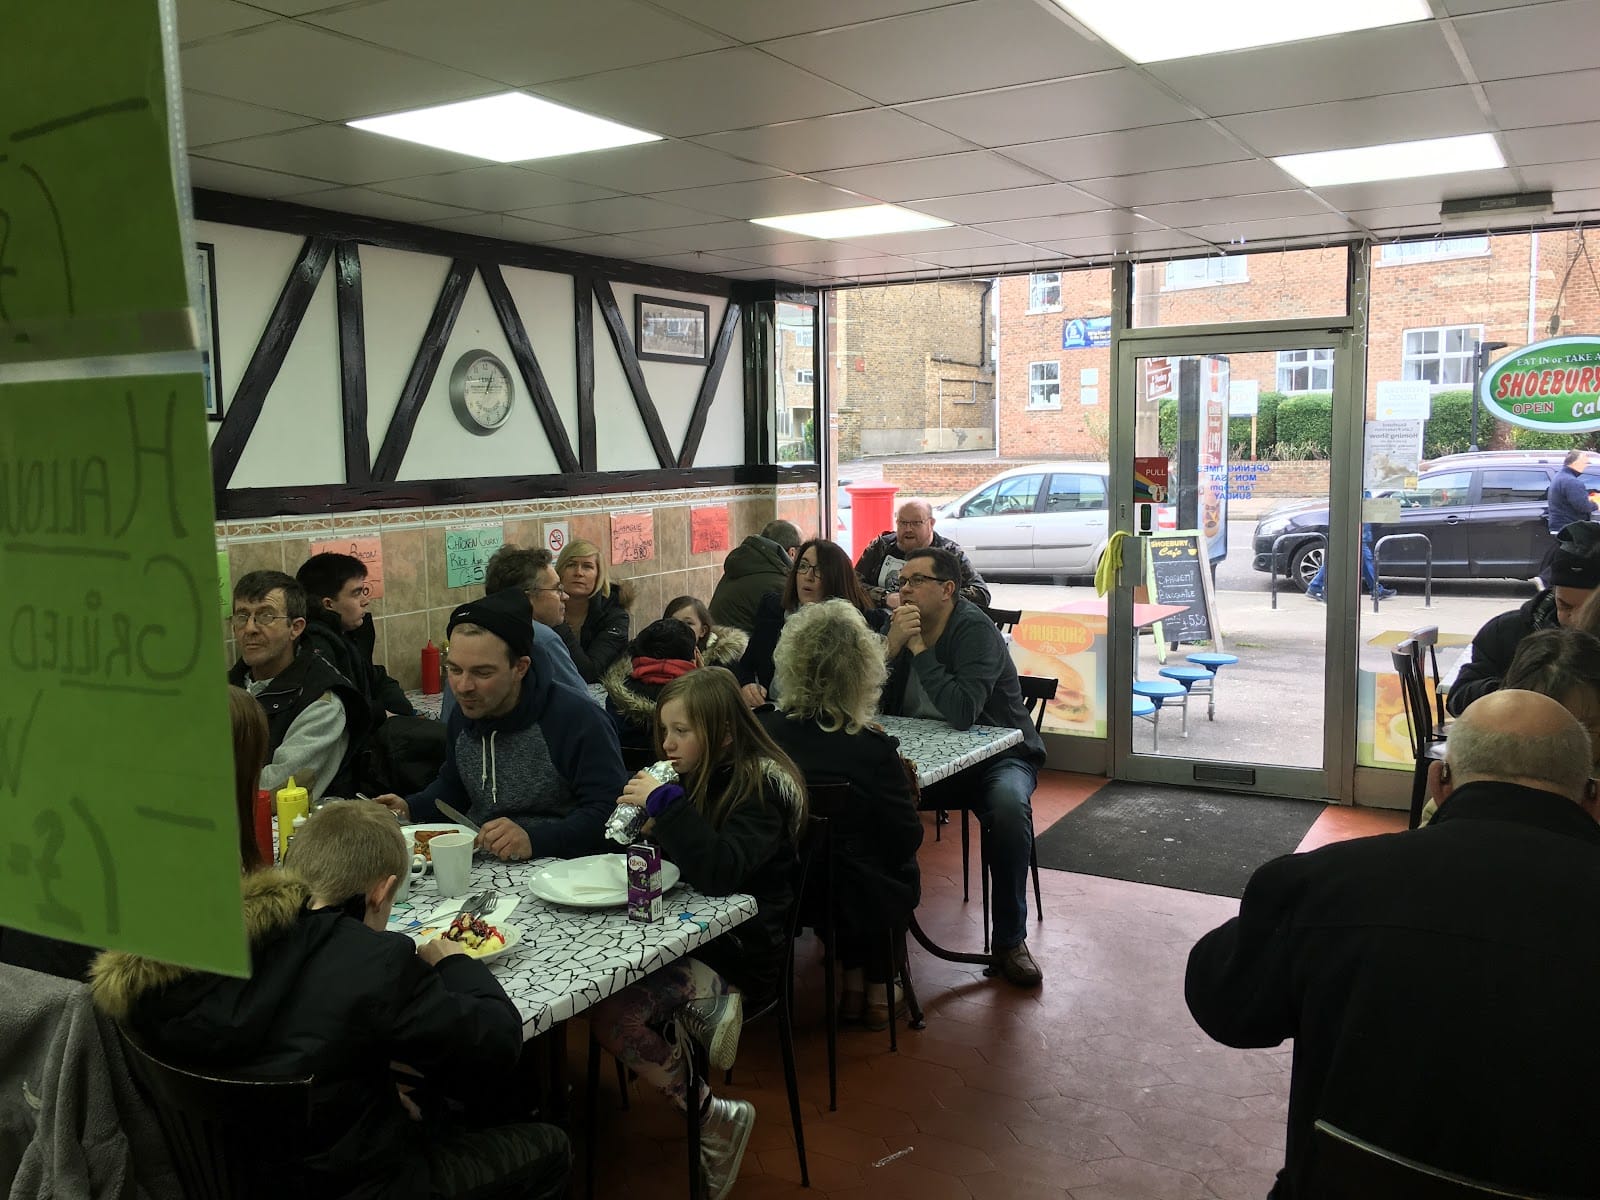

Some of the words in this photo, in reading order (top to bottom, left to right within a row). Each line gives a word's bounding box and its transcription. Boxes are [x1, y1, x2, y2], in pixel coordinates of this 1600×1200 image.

[1517, 357, 1536, 366] EAT
[1538, 356, 1550, 365] IN
[1565, 353, 1593, 363] TAKE
[1513, 401, 1555, 415] OPEN
[1145, 468, 1166, 477] PULL
[1150, 539, 1189, 548] SHOEBURY
